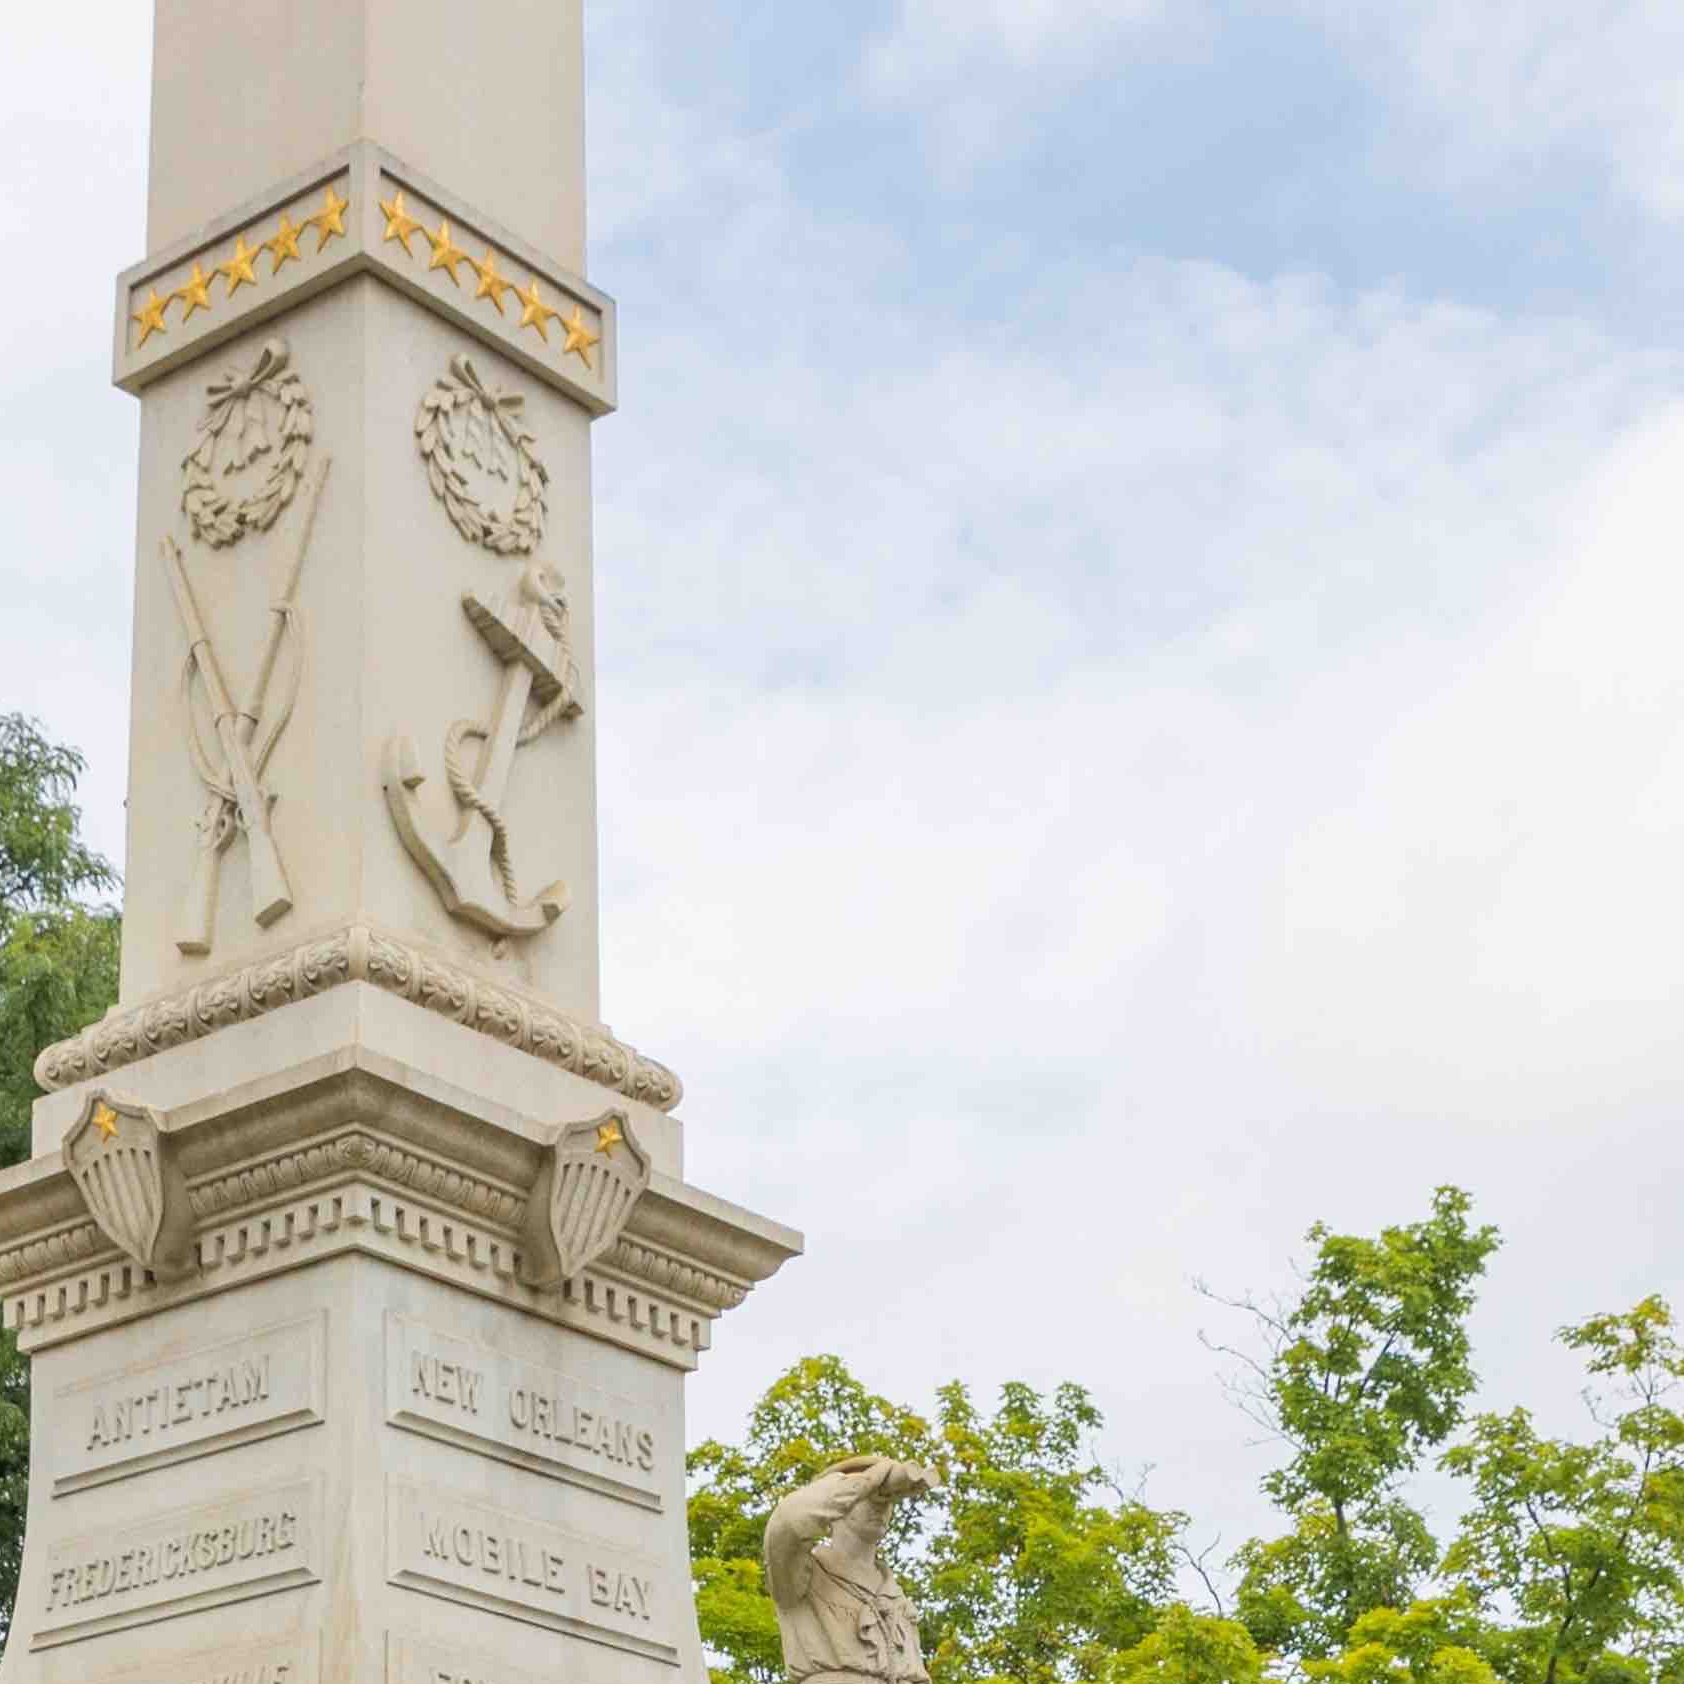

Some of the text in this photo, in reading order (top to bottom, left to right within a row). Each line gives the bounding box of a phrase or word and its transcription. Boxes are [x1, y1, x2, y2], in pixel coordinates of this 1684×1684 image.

[86, 1353, 271, 1451] ANTIETAM
[409, 1350, 656, 1471] NEW ORLEANS
[43, 1511, 297, 1613] FREDERICKSBURG
[423, 1512, 655, 1622] MOBILE BAY
